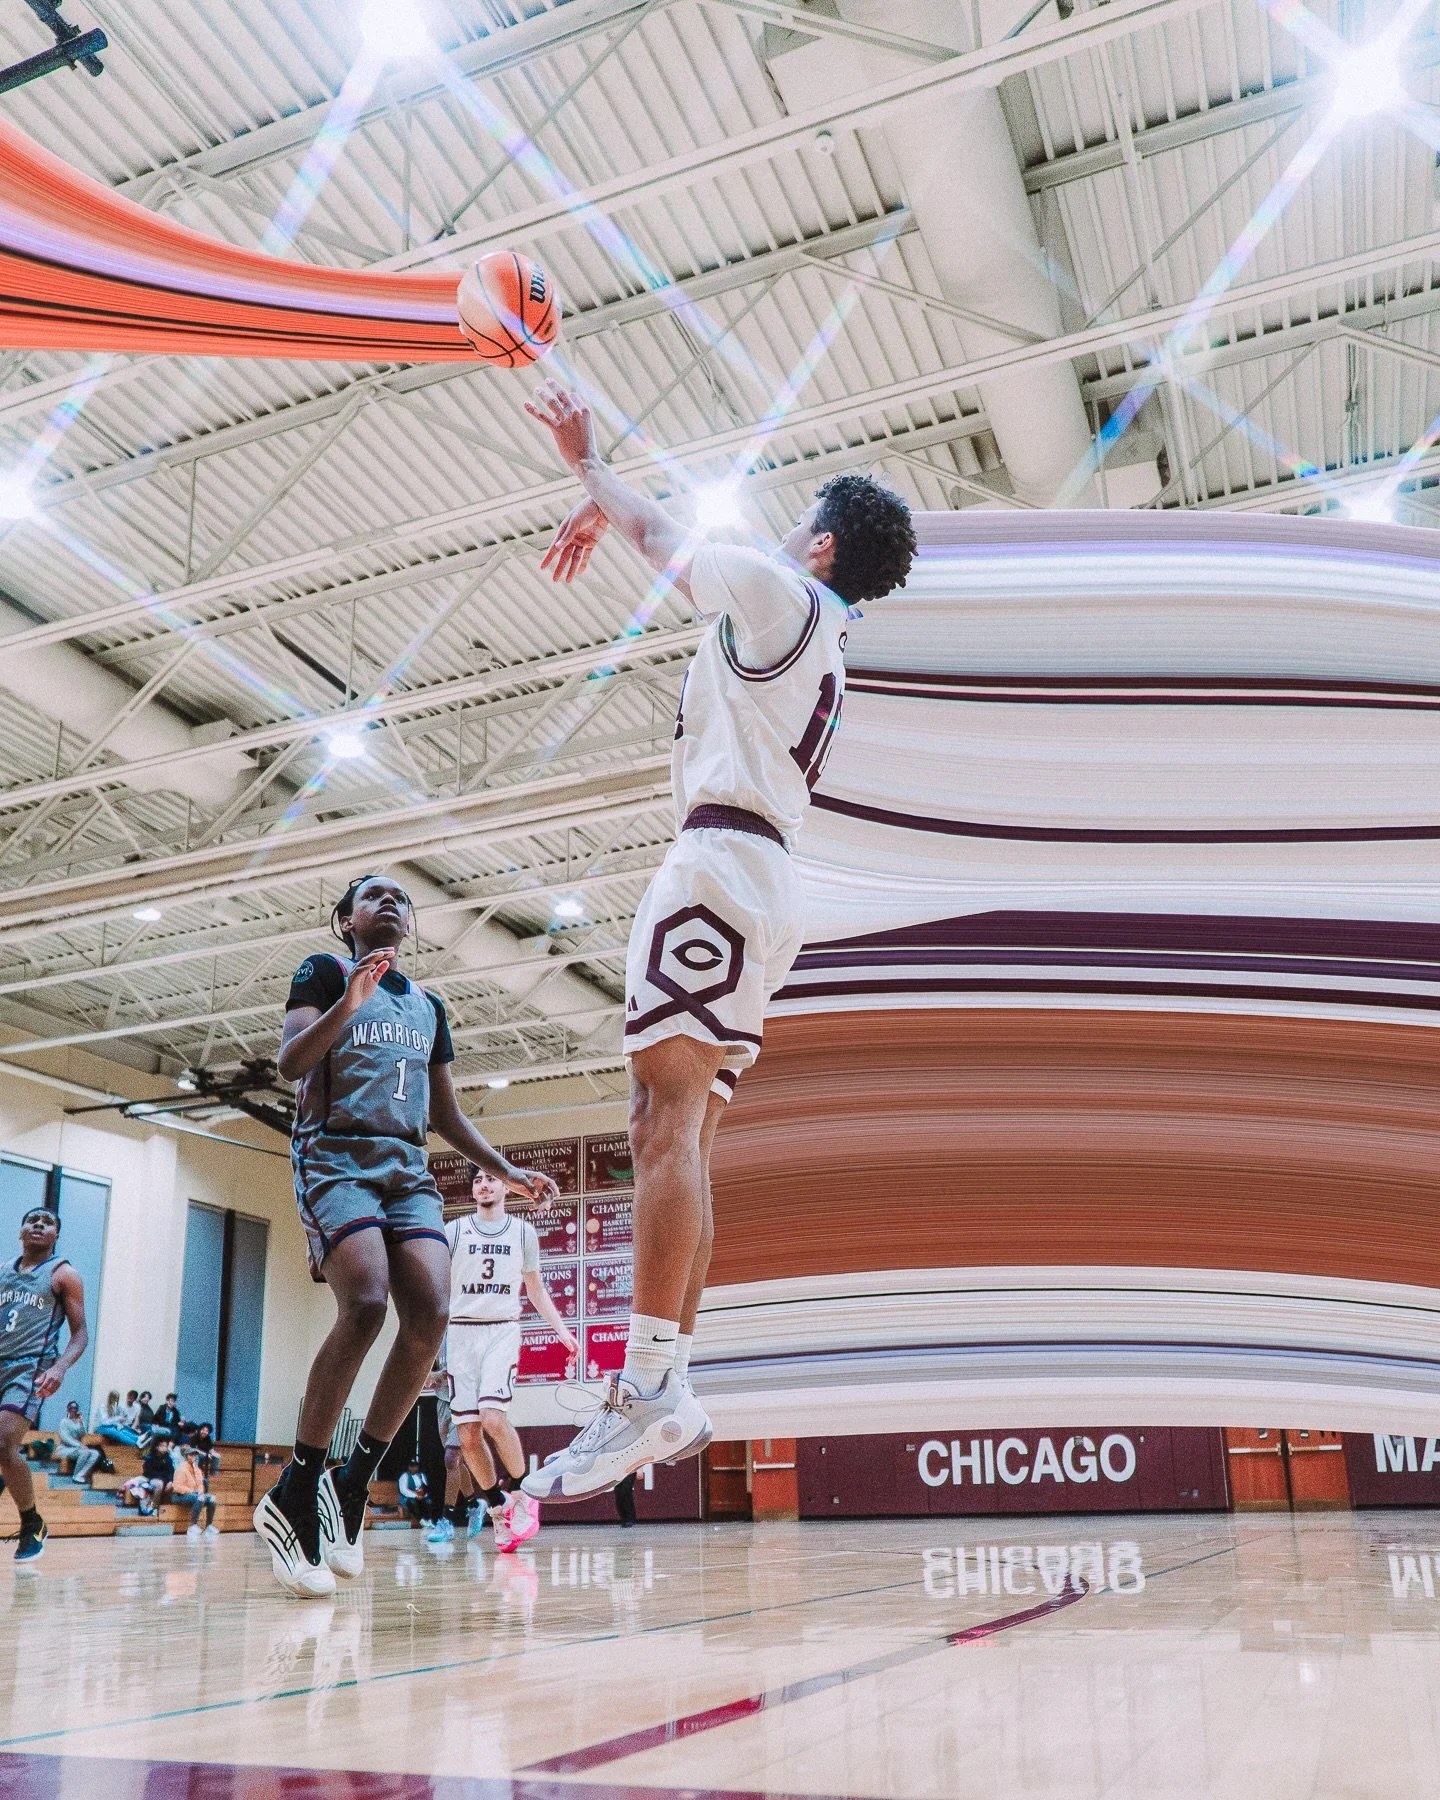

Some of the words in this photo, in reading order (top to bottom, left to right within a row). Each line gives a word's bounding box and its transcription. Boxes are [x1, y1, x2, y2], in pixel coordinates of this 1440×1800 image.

[352, 1021, 434, 1056] WARRIOR
[392, 1057, 407, 1102] 1
[511, 1146, 572, 1160] CHAMPIONS
[468, 1243, 511, 1256] U-HIGH
[481, 1258, 495, 1280] 3
[0, 1290, 44, 1310] ARRIORS
[5, 1309, 18, 1332] 3
[918, 1434, 1136, 1486] CHICAGO
